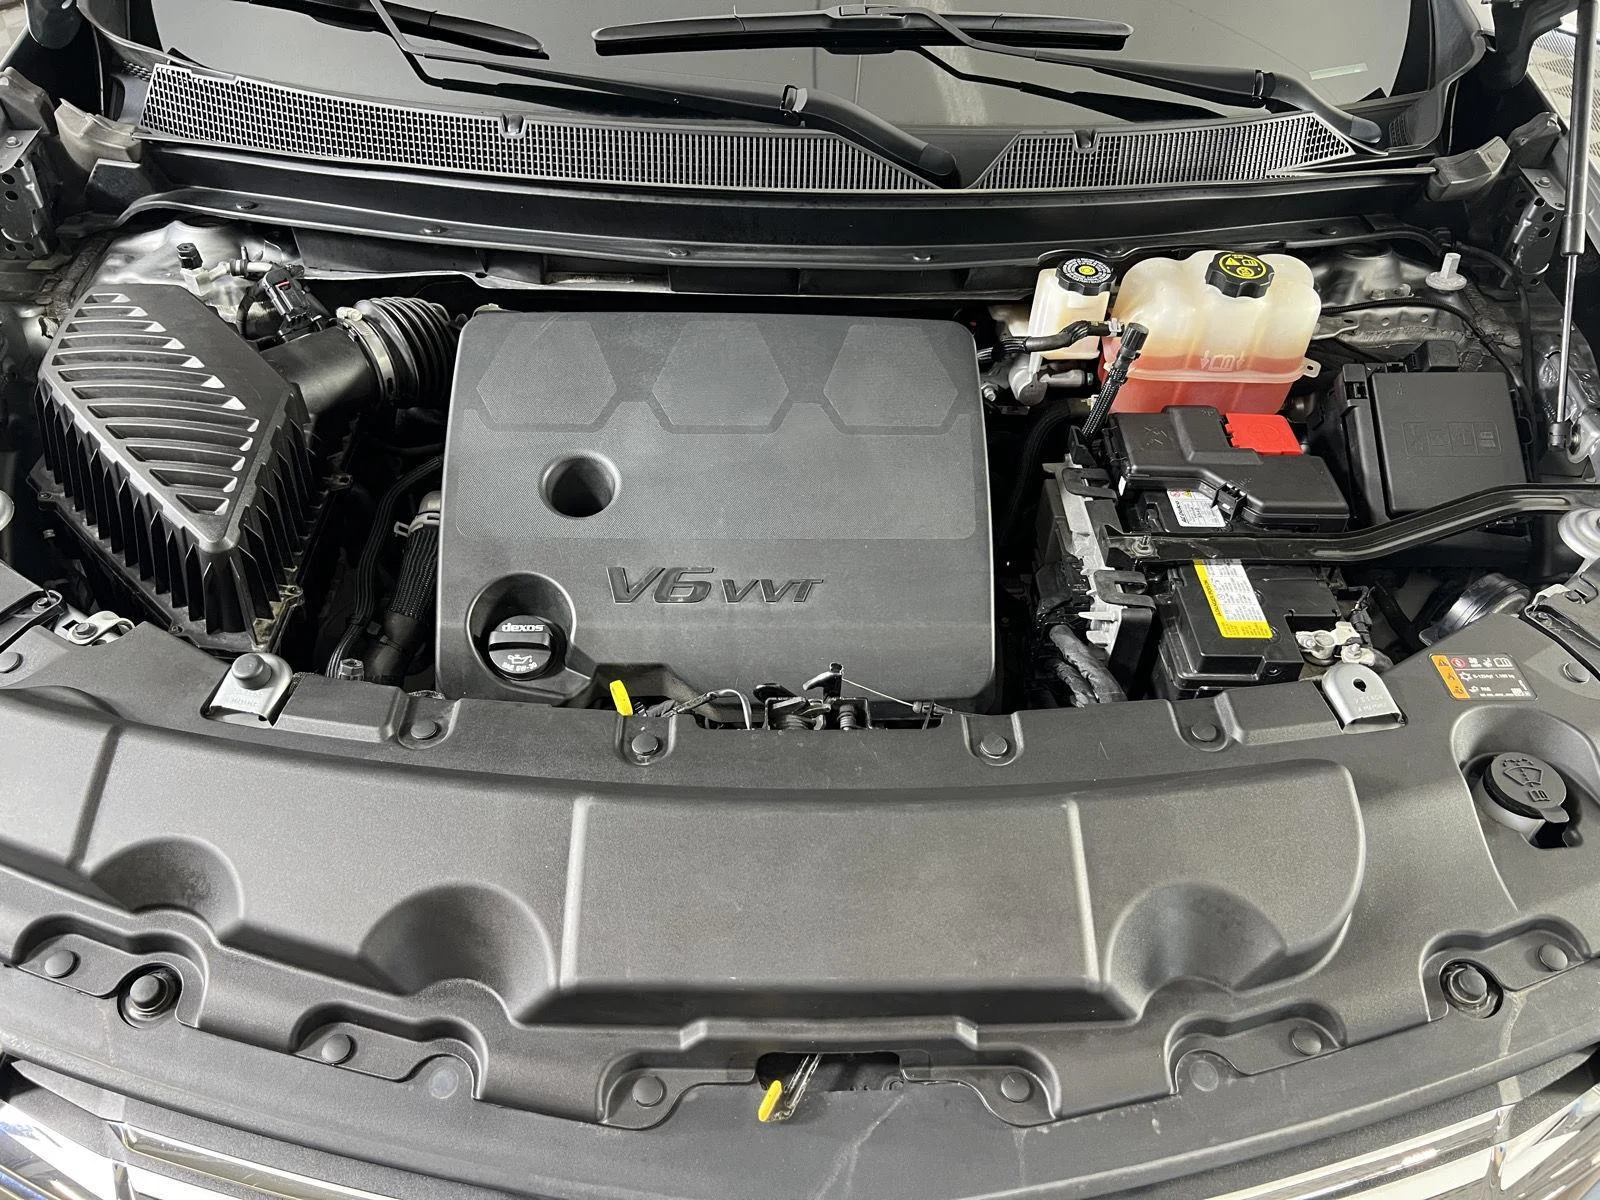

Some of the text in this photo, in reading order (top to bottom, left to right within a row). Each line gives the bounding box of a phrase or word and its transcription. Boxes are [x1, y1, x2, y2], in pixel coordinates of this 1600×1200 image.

[606, 566, 824, 604] V6 VVT
[501, 622, 545, 632] dexos
